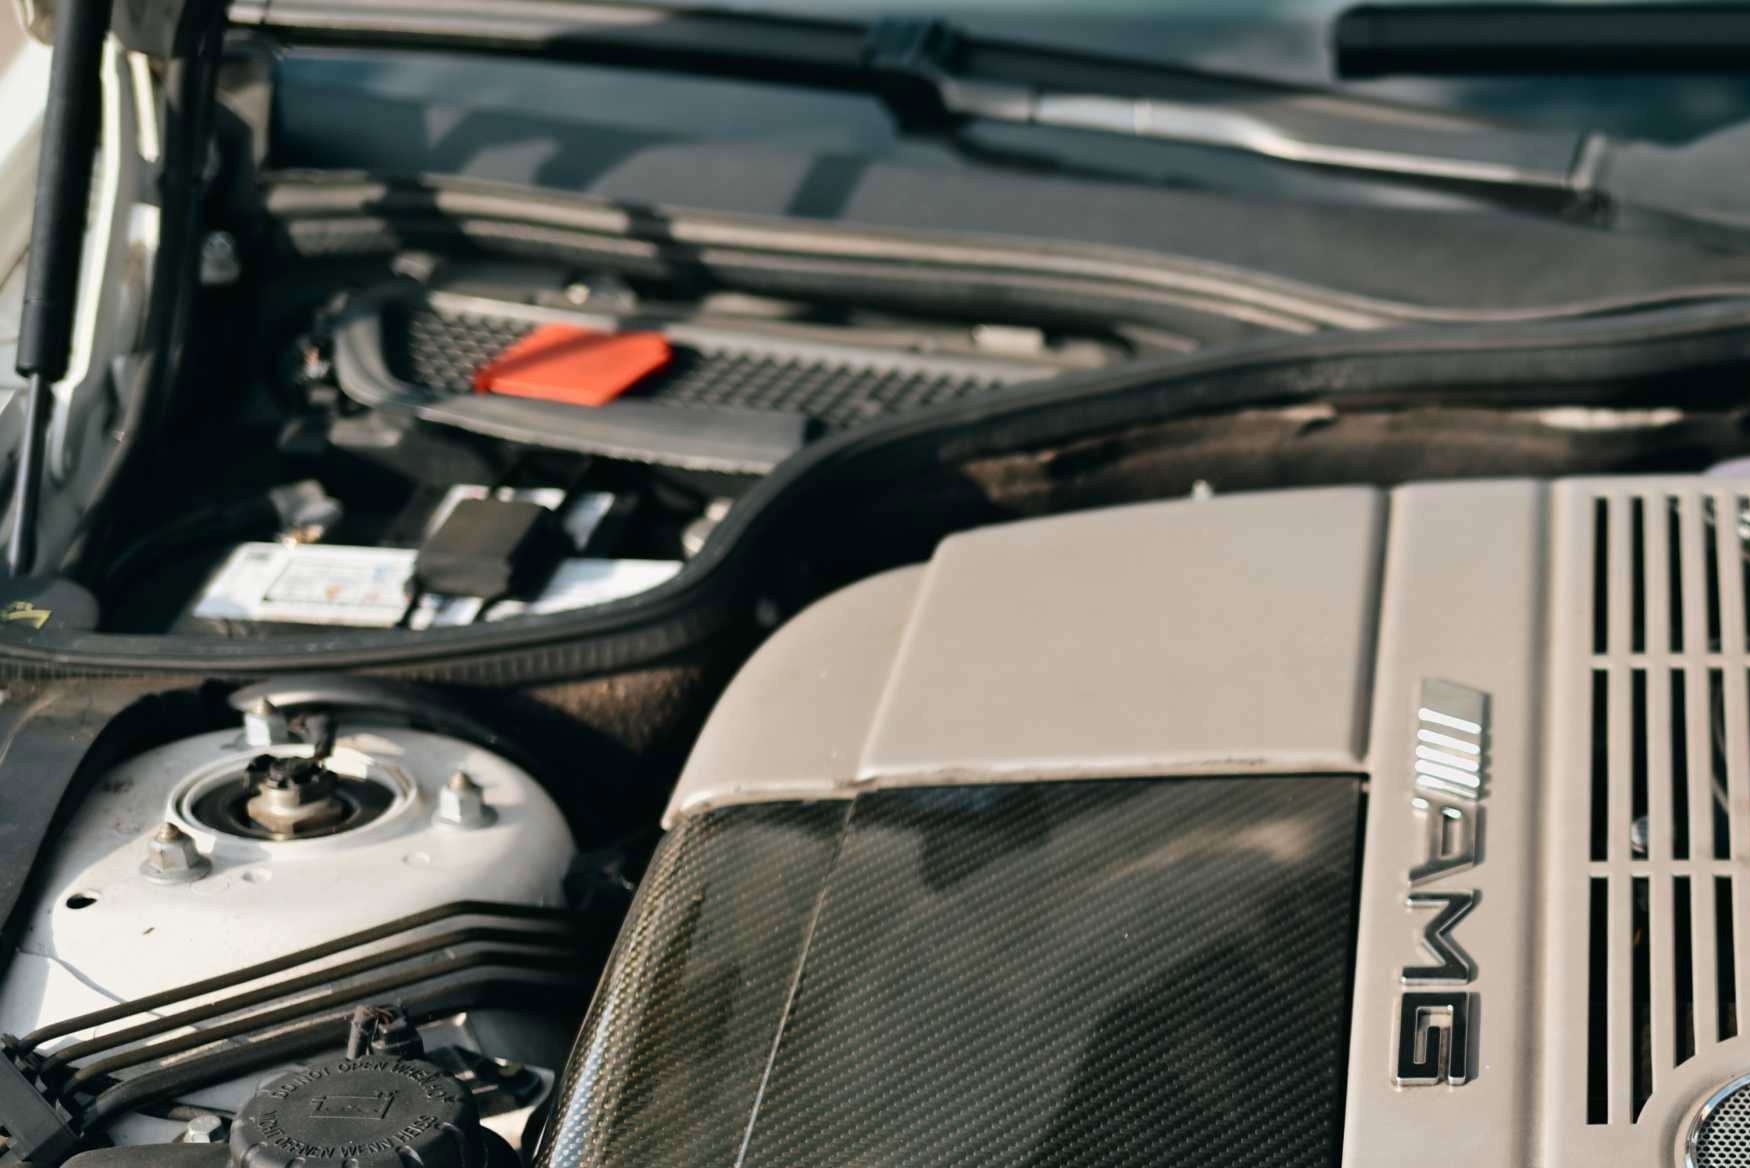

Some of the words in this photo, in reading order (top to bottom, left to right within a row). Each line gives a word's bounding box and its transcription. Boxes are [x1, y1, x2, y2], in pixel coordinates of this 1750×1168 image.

[1396, 797, 1478, 1086] AMG
[338, 1061, 388, 1073] OPEN
[340, 1137, 395, 1158] WENN
